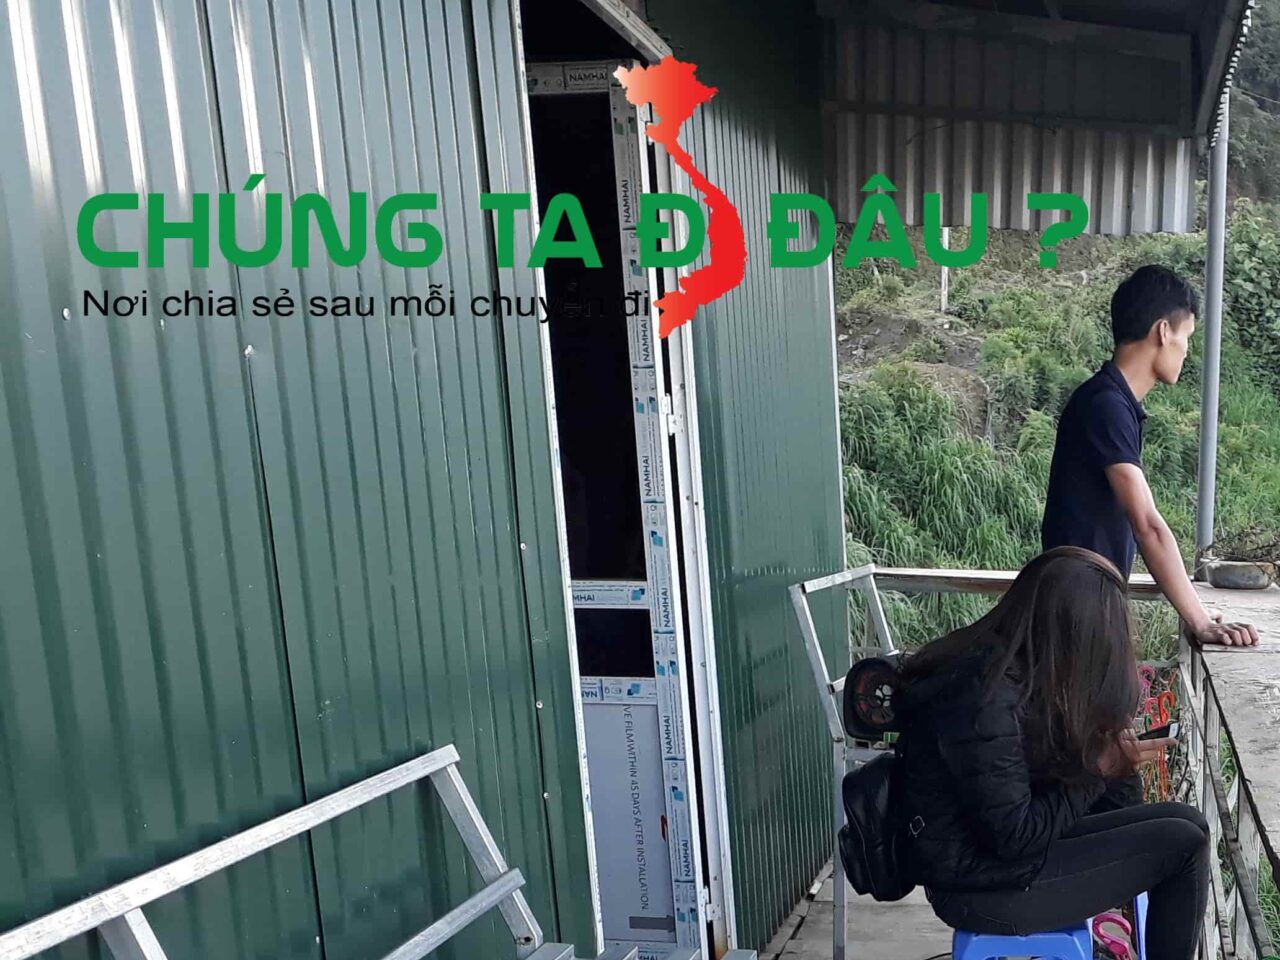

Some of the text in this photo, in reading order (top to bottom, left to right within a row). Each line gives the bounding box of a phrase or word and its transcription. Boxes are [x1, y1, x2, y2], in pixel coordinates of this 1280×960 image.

[622, 179, 632, 224] NAMHAI
[640, 319, 650, 362] NAMHAI
[642, 455, 652, 497] NAMHAI
[661, 587, 670, 628] NAMHAI
[664, 715, 673, 755] NAMHAI
[631, 780, 640, 791] 45
[632, 792, 642, 816] DAYS
[634, 817, 644, 846] AFTER
[682, 839, 691, 877] NAMHAI
[636, 847, 649, 910] INSTALLATION
